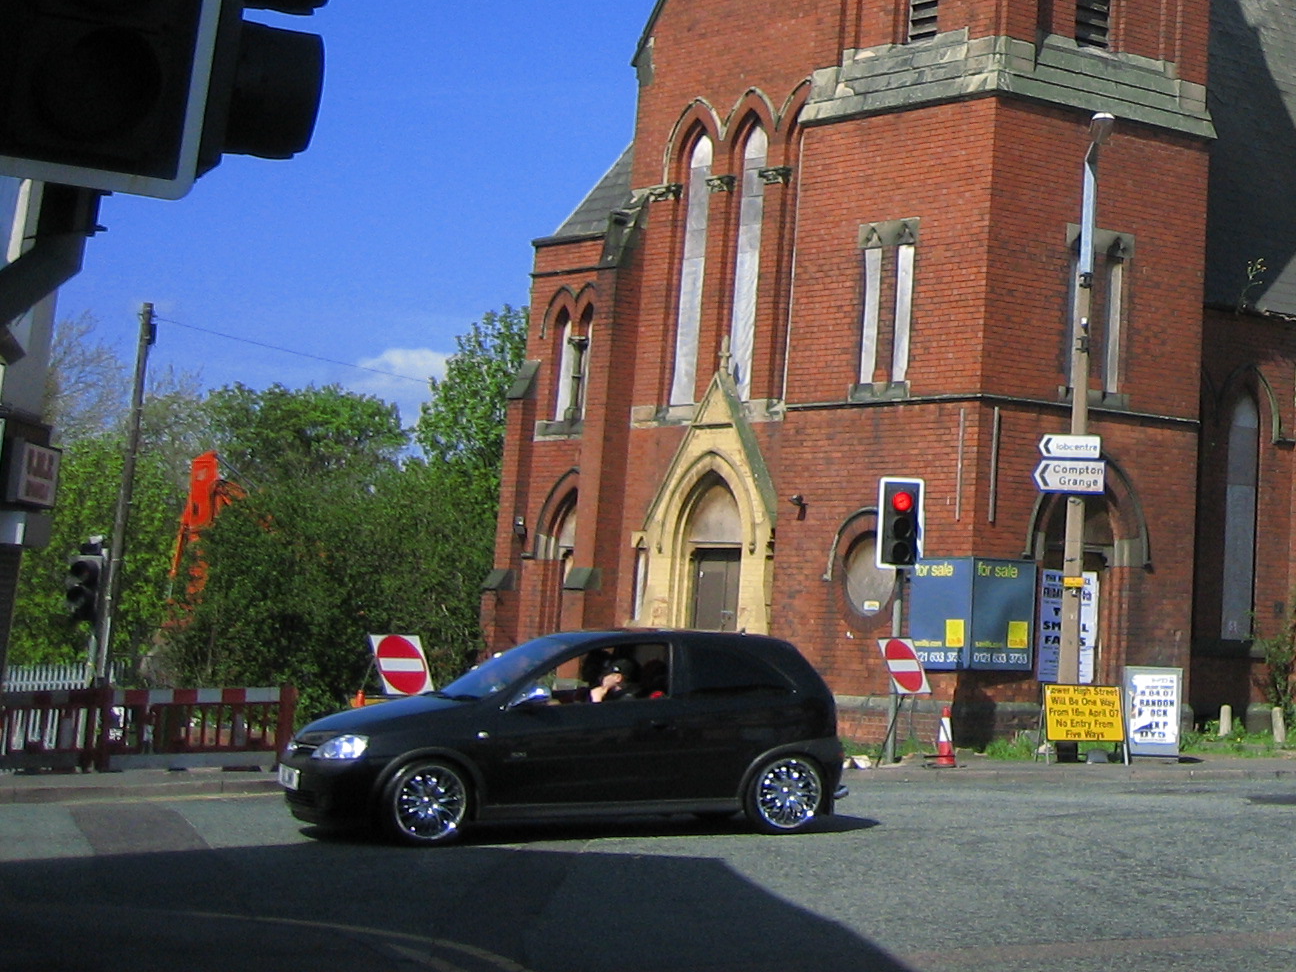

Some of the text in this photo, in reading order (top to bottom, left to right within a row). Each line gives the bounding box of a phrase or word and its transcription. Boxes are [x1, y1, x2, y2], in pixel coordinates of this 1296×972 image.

[1053, 464, 1104, 476] Compton
[1058, 476, 1099, 488] Grange
[931, 563, 954, 577] sale
[977, 561, 1019, 578] for sale
[1042, 621, 1089, 633] SML
[1044, 635, 1087, 647] FAS
[973, 653, 991, 664] 0121
[1073, 686, 1092, 697] High
[1094, 687, 1118, 696] Street
[1050, 697, 1116, 708] Will Be One Way
[1048, 708, 1069, 717] From
[1088, 708, 1107, 718] April
[1108, 710, 1120, 718] 07
[1056, 719, 1115, 729] No Entry From
[1065, 730, 1106, 739] Five Ways
